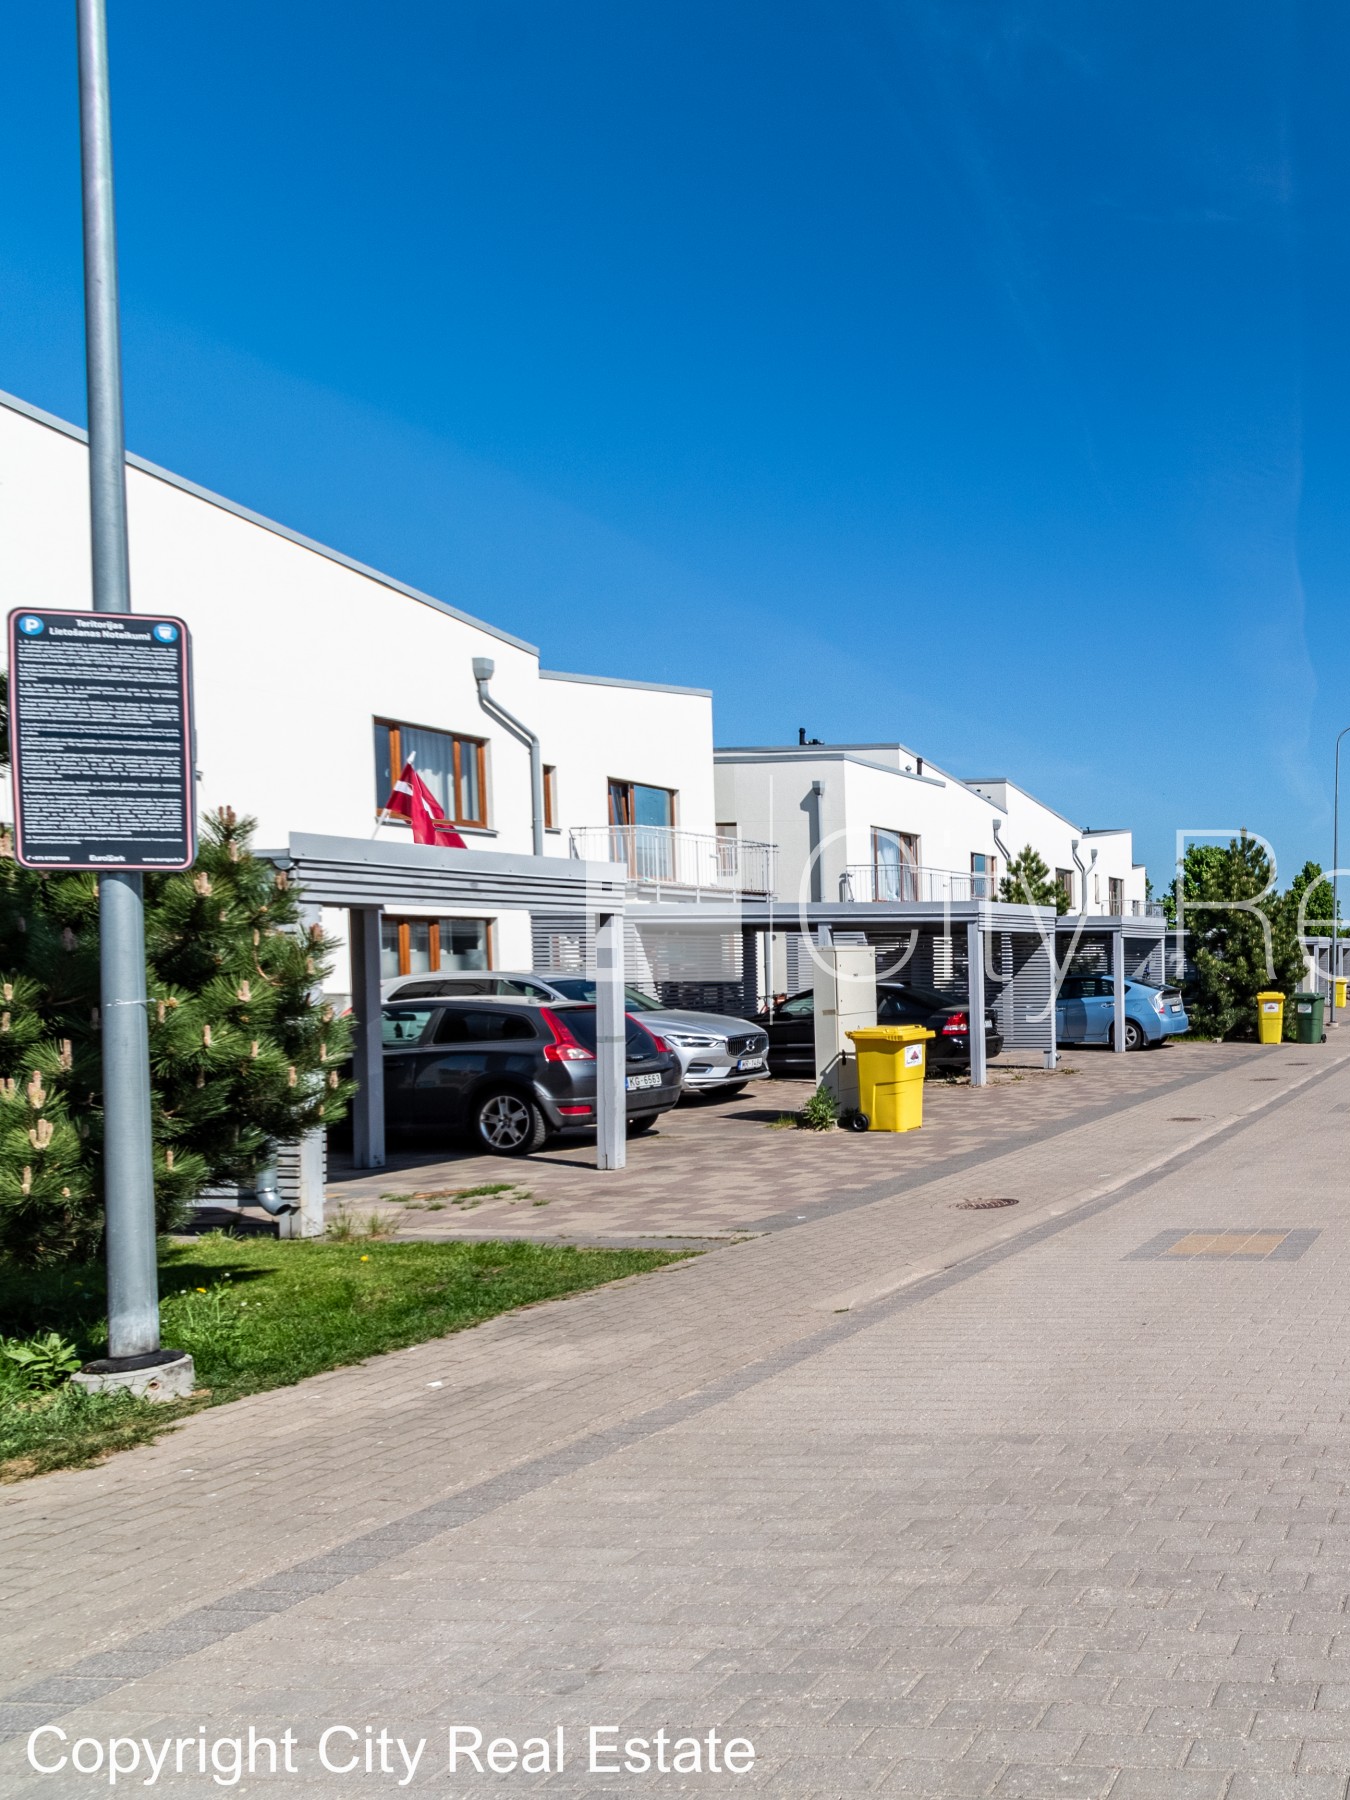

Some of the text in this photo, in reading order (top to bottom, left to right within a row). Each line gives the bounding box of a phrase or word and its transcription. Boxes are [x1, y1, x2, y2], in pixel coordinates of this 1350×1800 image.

[75, 618, 125, 630] Teritorijas
[48, 627, 152, 641] Lietošanas Noteikumi
[629, 1073, 661, 1087] KG-6563
